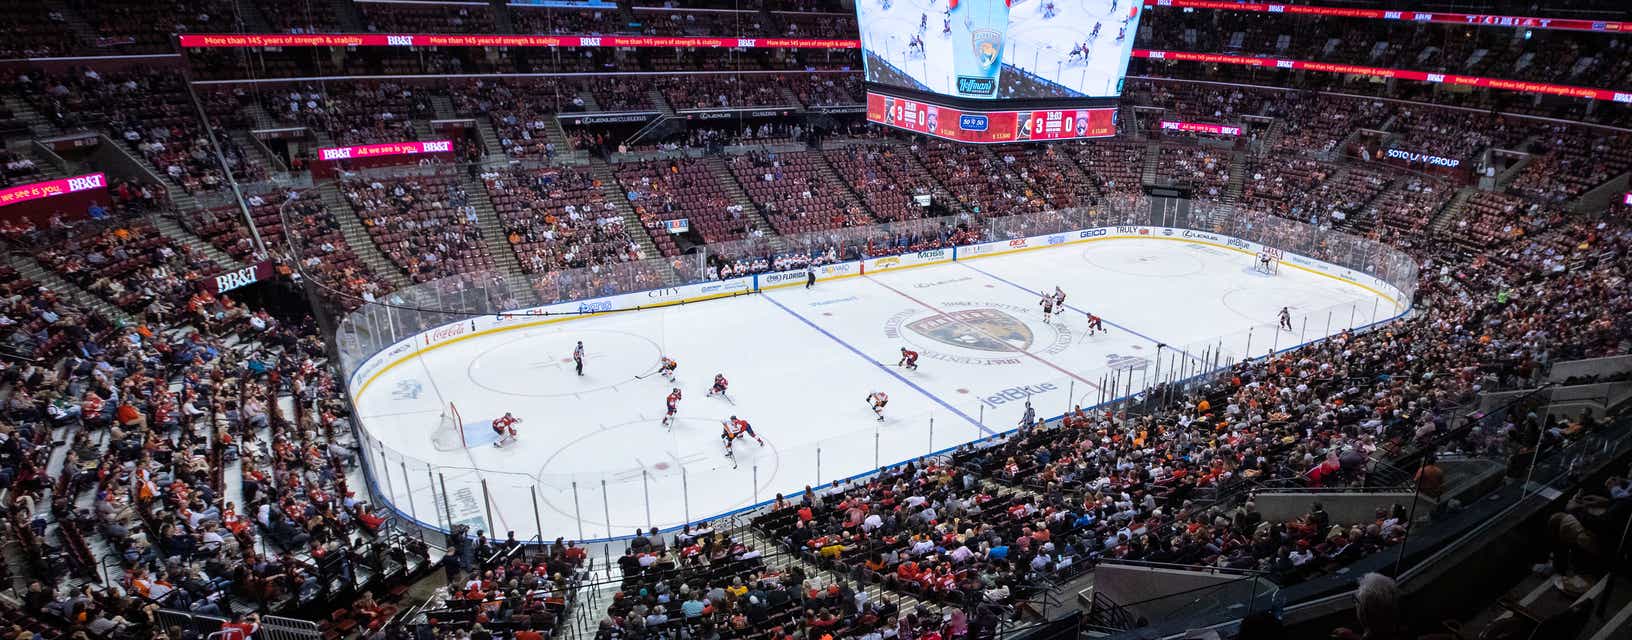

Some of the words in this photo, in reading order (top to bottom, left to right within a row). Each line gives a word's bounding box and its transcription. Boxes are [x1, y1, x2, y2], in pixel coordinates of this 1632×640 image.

[263, 38, 284, 46] years
[294, 36, 324, 45] strength
[334, 36, 362, 45] stability
[388, 36, 413, 45] BB&T
[503, 37, 528, 46] strength
[536, 37, 560, 46] stability
[581, 38, 601, 46] BB&T
[897, 106, 903, 120] 3
[919, 110, 924, 126] 0
[1036, 118, 1043, 133] 3
[1066, 117, 1072, 132] 0
[323, 148, 352, 160] BB&T
[423, 141, 449, 152] BB&T
[1388, 149, 1409, 159] SOTO
[1429, 156, 1459, 167] GROUP
[67, 175, 102, 192] BB&T
[1080, 229, 1106, 238] GEICO
[1226, 238, 1250, 249] jetBlue
[216, 266, 258, 293] BB&T
[783, 272, 806, 281] FLORIDA
[648, 287, 679, 297] CITY
[976, 382, 1058, 409] jetBlue
